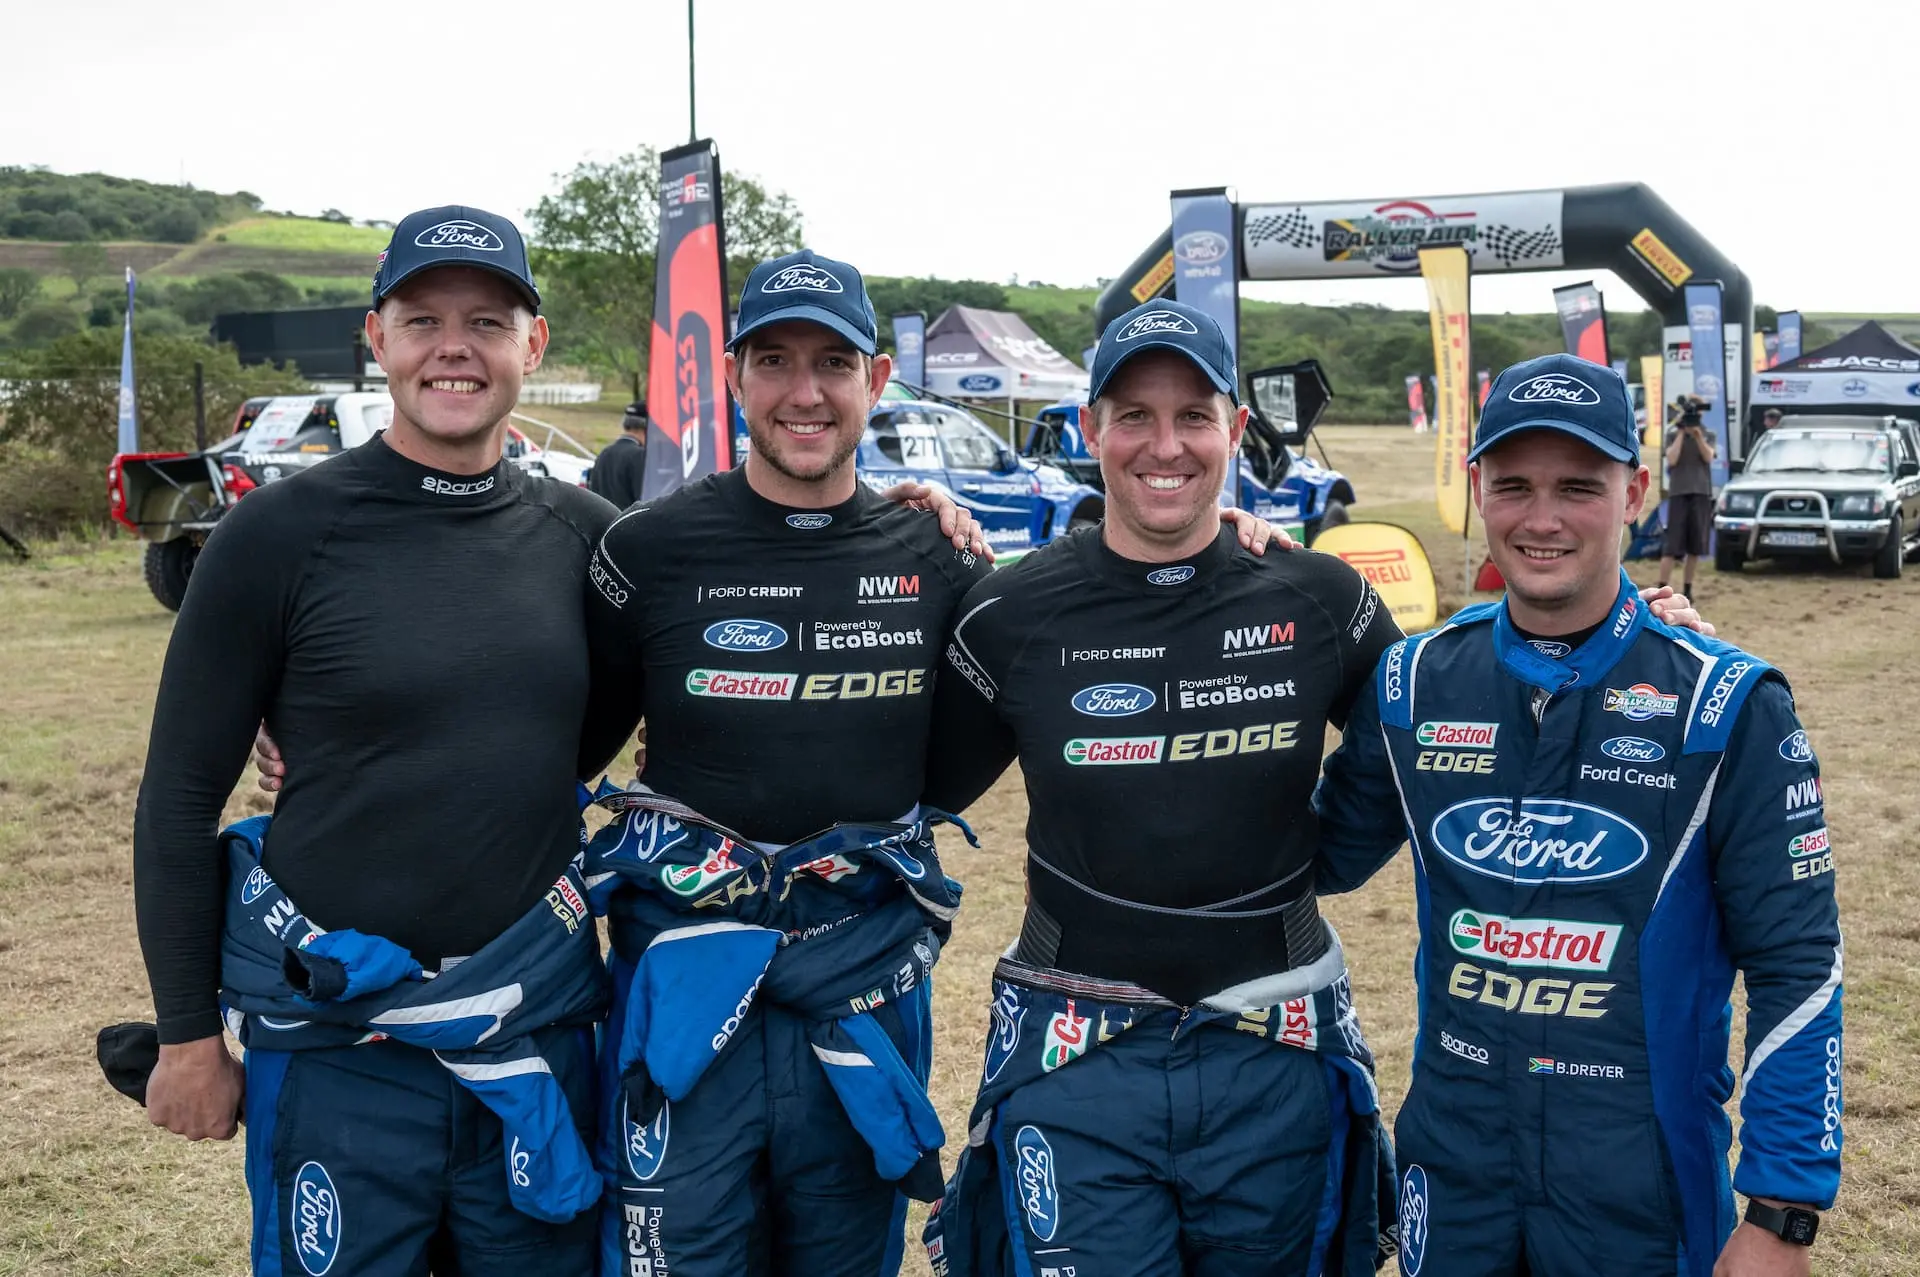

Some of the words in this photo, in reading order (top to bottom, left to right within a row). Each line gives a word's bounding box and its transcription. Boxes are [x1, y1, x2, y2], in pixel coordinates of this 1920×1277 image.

[430, 224, 490, 248] Ford
[774, 268, 829, 289] Ford
[1128, 313, 1182, 337] Ford
[1524, 379, 1584, 401] Ford
[422, 476, 494, 495] sparco
[794, 516, 825, 526] Ford
[858, 575, 919, 596] NWM
[1156, 569, 1188, 582] Ford
[708, 587, 747, 598] FORD
[749, 586, 804, 597] CREDIT
[718, 624, 773, 647] Ford
[815, 621, 865, 631] Powered
[868, 620, 882, 631] by
[1223, 621, 1295, 651] NWM
[815, 628, 924, 650] EcoBoost
[1534, 641, 1562, 656] Ford
[1072, 650, 1109, 662] FORD
[1112, 647, 1166, 659] CREDIT
[947, 643, 994, 702] sparco
[1179, 676, 1231, 690] Powered
[1234, 674, 1248, 685] by
[1386, 641, 1407, 702] sparco
[709, 675, 788, 696] Castrol
[800, 669, 926, 700] EDGE
[1179, 679, 1296, 709] EcoBoost
[1700, 661, 1751, 727] sparco
[1086, 688, 1141, 712] Ford
[1606, 696, 1675, 709] RALLY-RAID
[1168, 720, 1301, 762] EDGE
[1436, 725, 1493, 745] Castrol
[1087, 741, 1157, 761] Castrol
[1612, 737, 1653, 760] Ford
[1416, 751, 1497, 774] EDGE
[1580, 765, 1620, 783] Ford
[1625, 769, 1677, 790] Credit
[1465, 807, 1608, 871] Ford
[1483, 920, 1607, 964] Castrol
[1448, 962, 1617, 1018] EDGE
[1440, 1031, 1489, 1065] sparco
[1556, 1062, 1625, 1079] B.DREYER
[1820, 1036, 1840, 1152] sparco
[1021, 1146, 1052, 1221] Ford
[300, 1180, 334, 1257] Ford
[1402, 1180, 1424, 1261] Ford
[649, 1206, 668, 1268] Powered
